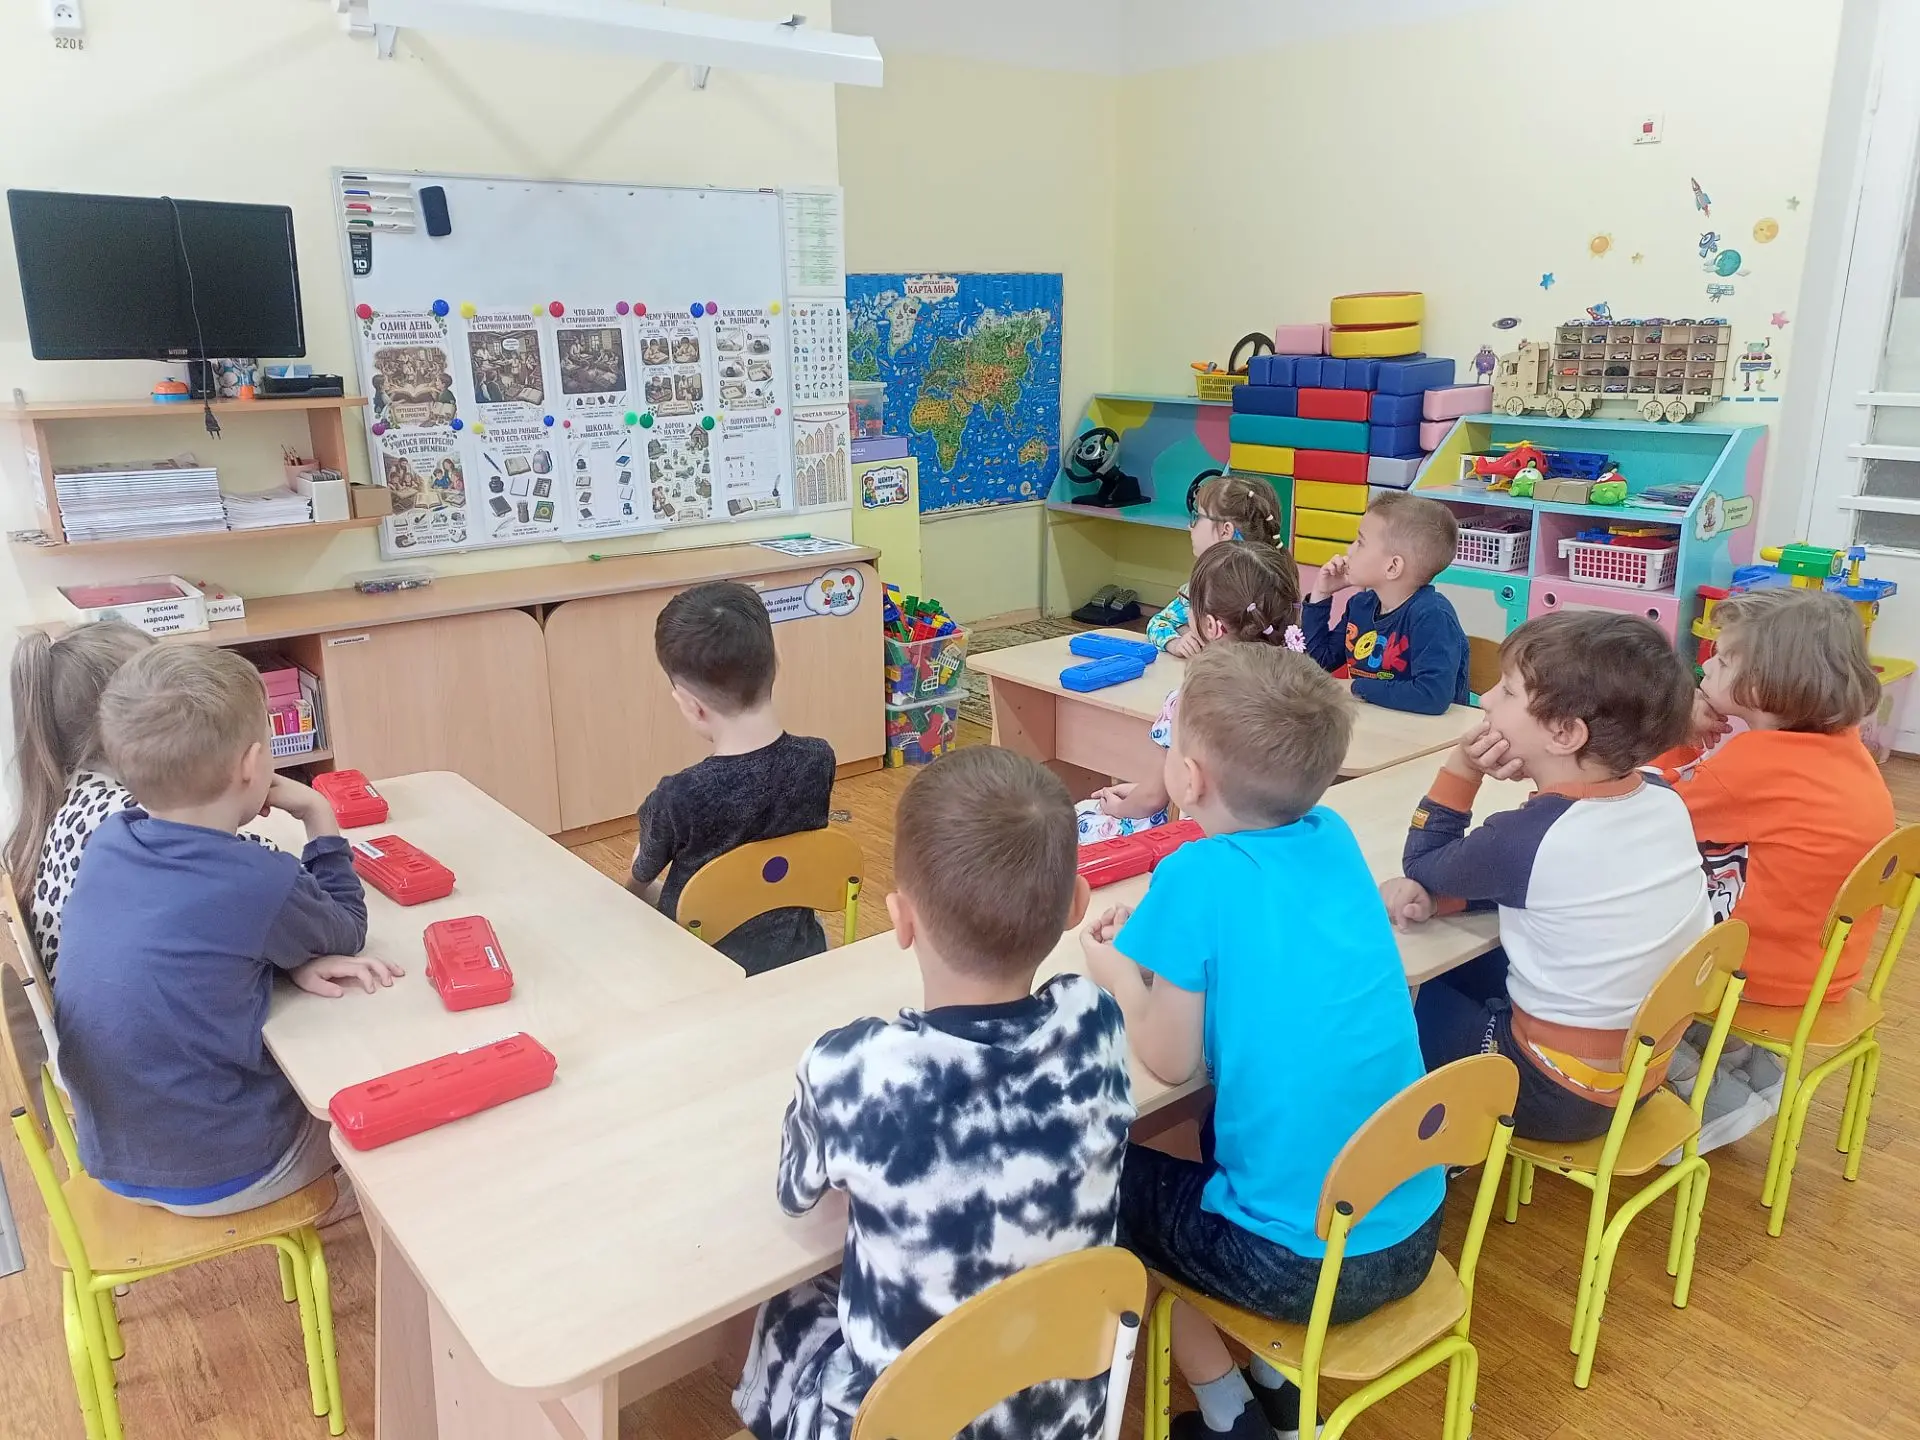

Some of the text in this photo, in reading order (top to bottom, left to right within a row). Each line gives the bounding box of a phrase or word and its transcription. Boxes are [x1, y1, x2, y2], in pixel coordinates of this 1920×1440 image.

[353, 259, 368, 269] 10
[907, 285, 956, 294] КАРТА МИРА
[587, 308, 605, 316] БЫЛО
[645, 312, 690, 320] ЧЕМУ УЧИЛИСЬ
[722, 309, 763, 317] КАК ПИСАЛИ
[493, 314, 532, 322] ПОЖАЛОВАТЬ
[380, 320, 432, 332] ОДИН ДЕНЬ
[659, 319, 679, 327] ДЕТИ?
[377, 331, 417, 340] СТАРИННОЙ
[585, 423, 614, 432] ШКОЛА:
[389, 437, 454, 449] УЧИТЬСЯ ИНТЕРЕСНО
[493, 435, 505, 443] ЧТО
[398, 447, 407, 455] ВО
[408, 446, 419, 454] ВСЕ
[877, 475, 894, 485] ЦЕНТР
[146, 604, 179, 614] Русские
[143, 613, 185, 624] народные
[152, 624, 180, 633] сказки
[1345, 622, 1409, 672] ROCK
